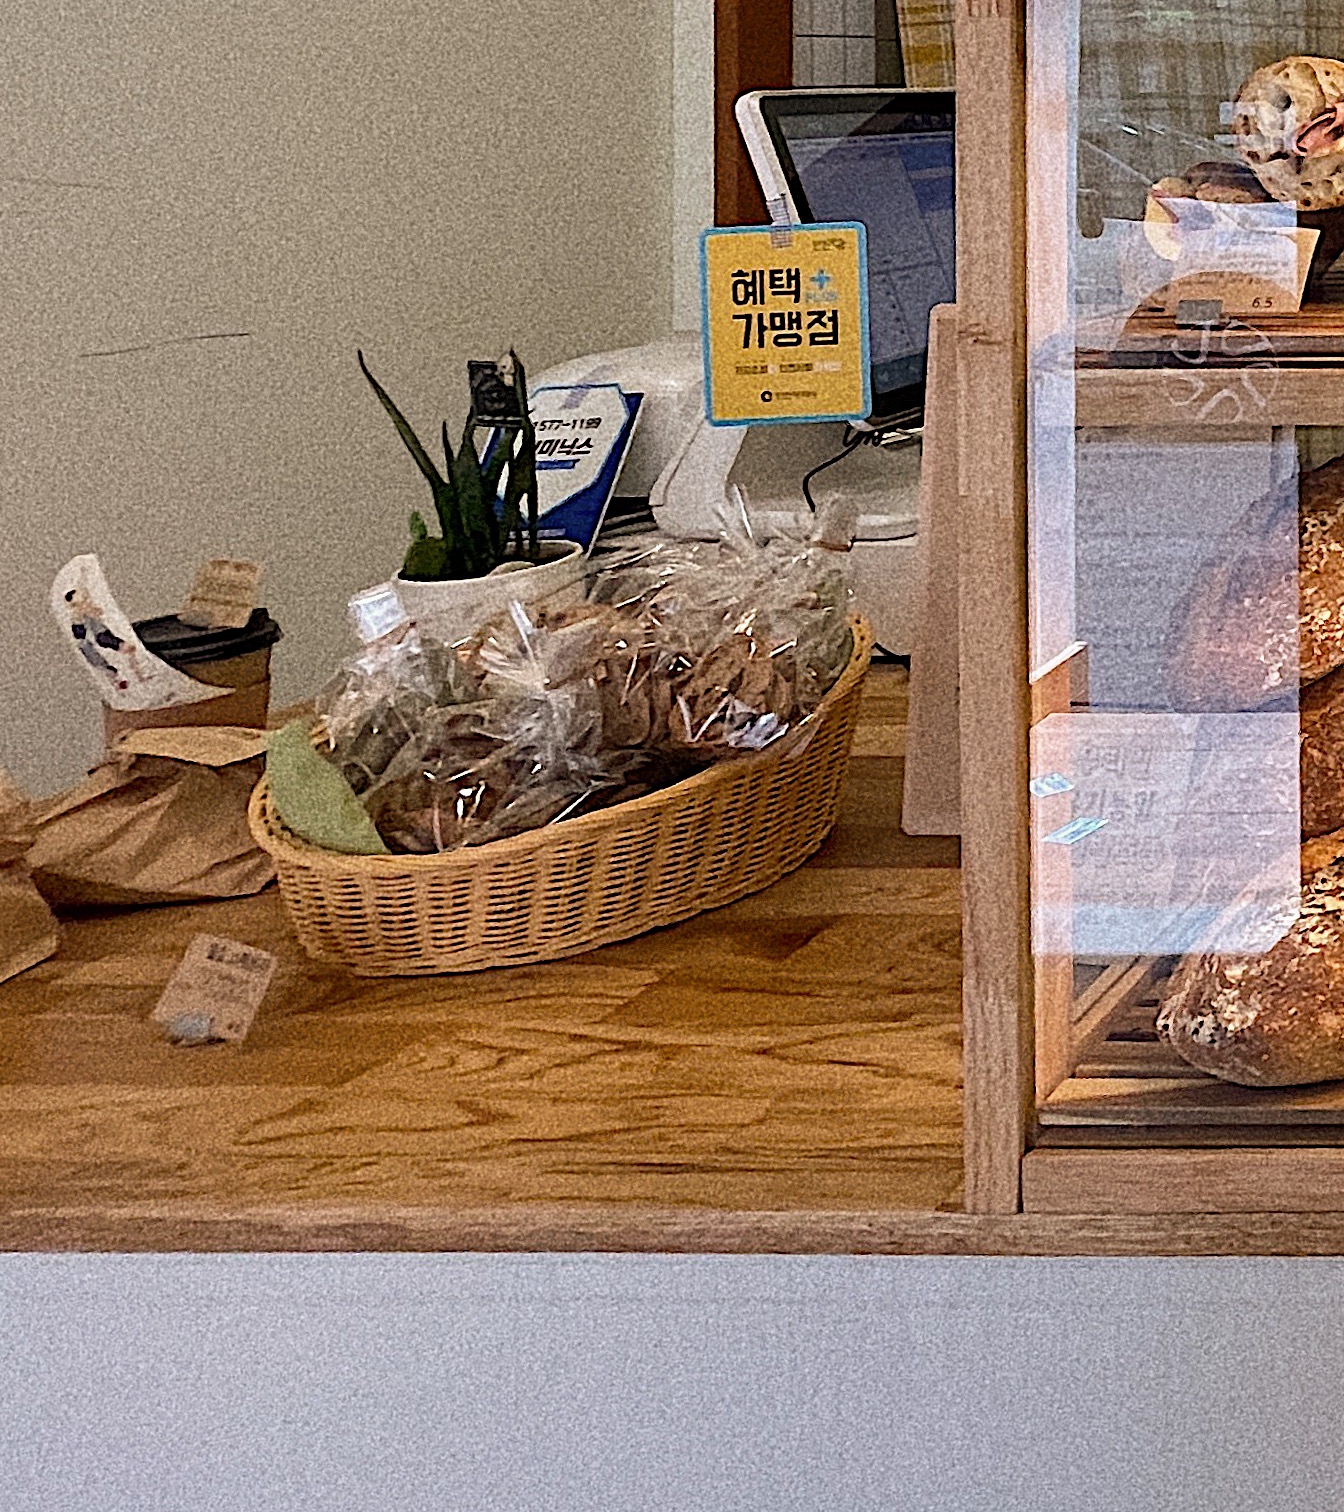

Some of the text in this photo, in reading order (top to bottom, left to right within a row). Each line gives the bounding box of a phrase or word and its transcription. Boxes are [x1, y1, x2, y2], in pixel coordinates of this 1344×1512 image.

[731, 268, 800, 306] 혜택
[732, 310, 839, 348] 가맹점
[535, 438, 593, 456] 미닉스
